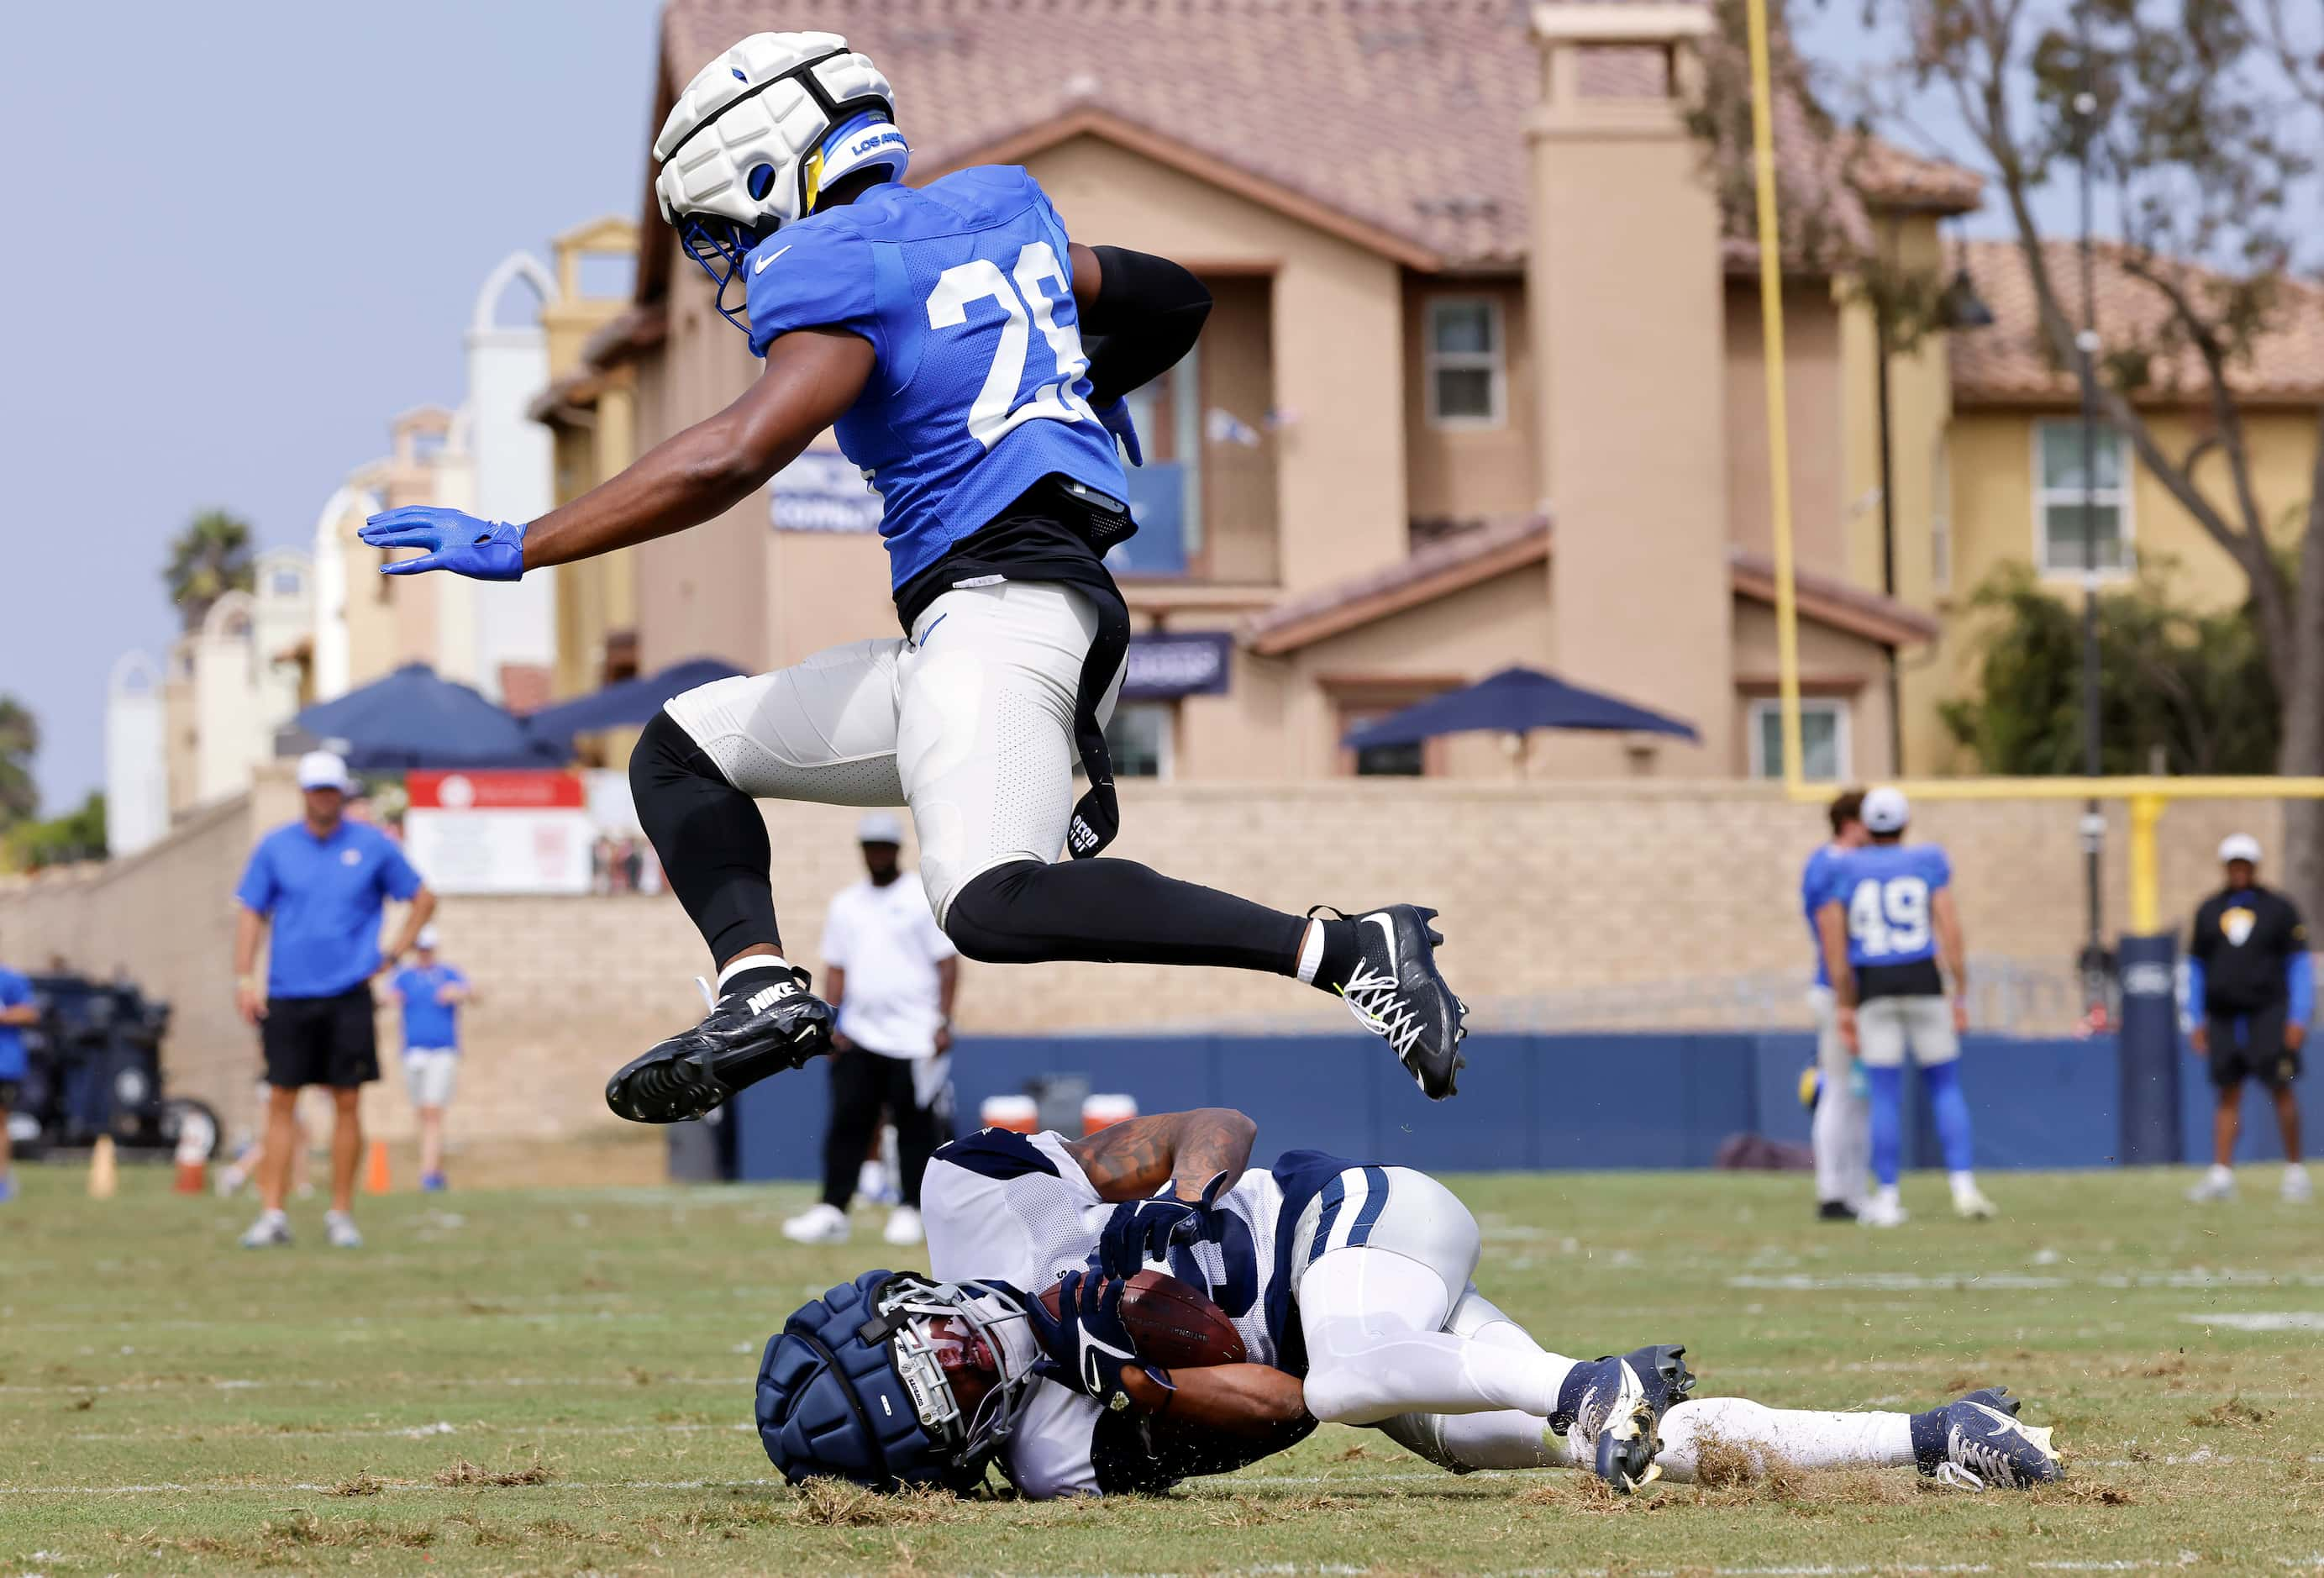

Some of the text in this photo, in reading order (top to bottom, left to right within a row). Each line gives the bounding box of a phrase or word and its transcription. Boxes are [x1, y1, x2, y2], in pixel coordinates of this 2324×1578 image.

[851, 136, 881, 156] LOS
[926, 240, 1103, 455] 26
[1848, 875, 1931, 957] 49
[745, 981, 800, 1017] NIKE
